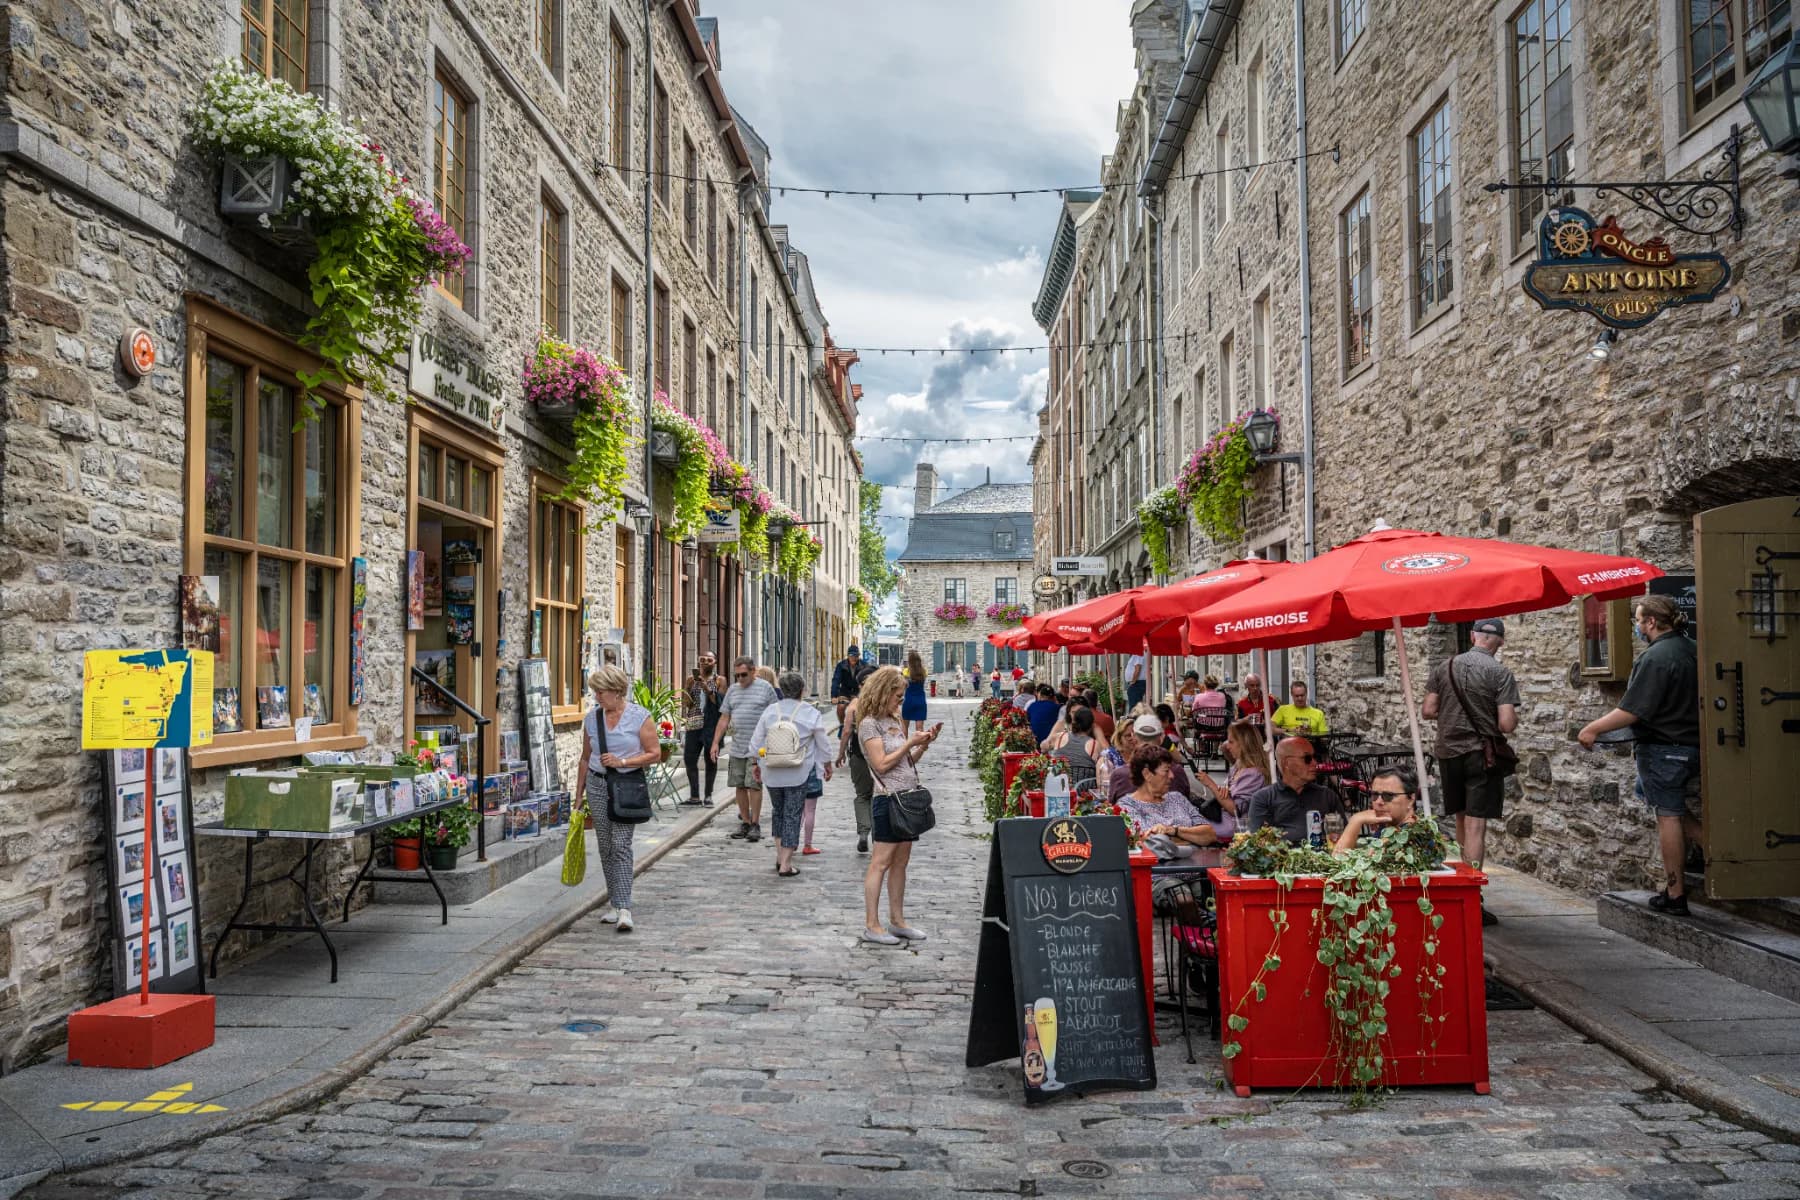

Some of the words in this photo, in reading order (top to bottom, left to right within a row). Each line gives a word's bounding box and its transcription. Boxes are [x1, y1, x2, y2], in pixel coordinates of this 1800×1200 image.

[1602, 233, 1669, 262] ONCLE
[1560, 268, 1698, 293] ANTOINE
[1577, 566, 1646, 585] ST-AMBROISE
[1214, 611, 1309, 635] ST-AMBROISE
[1048, 845, 1089, 857] GRIFFON
